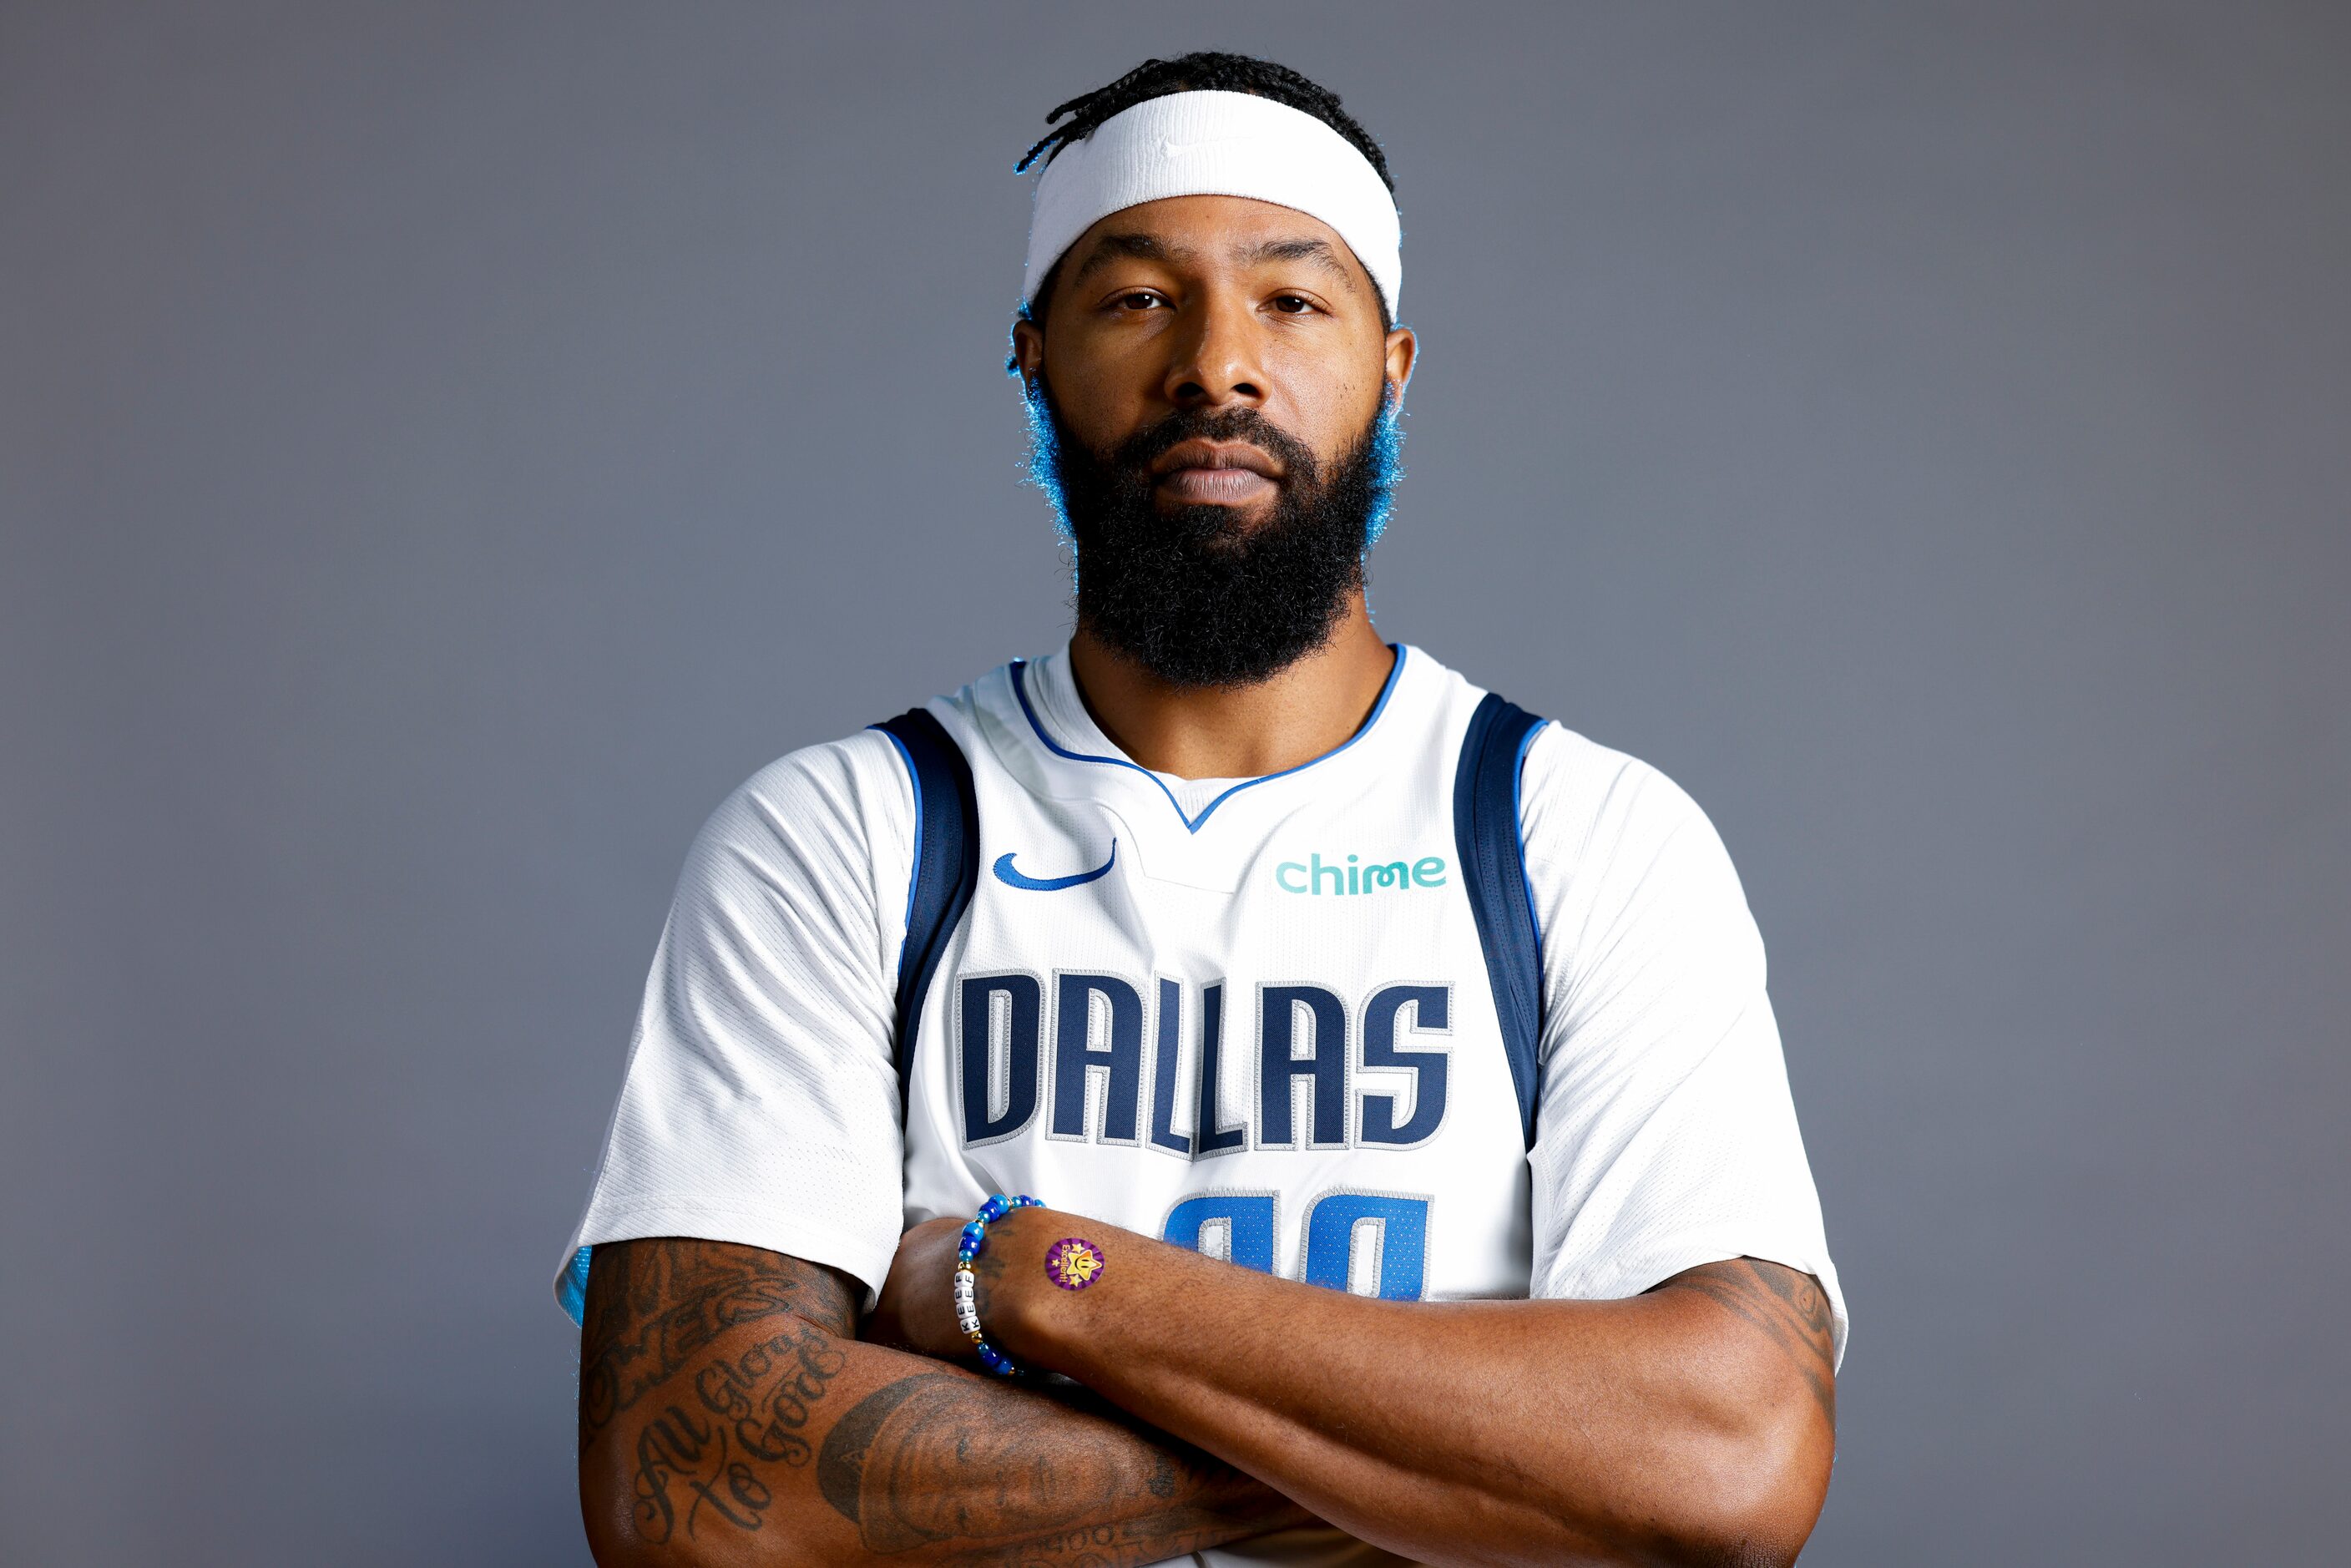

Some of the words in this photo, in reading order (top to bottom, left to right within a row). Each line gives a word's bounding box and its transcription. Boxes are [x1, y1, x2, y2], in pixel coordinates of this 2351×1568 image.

[1276, 852, 1447, 896] chime
[955, 968, 1456, 1162] DALLAS
[1059, 1244, 1070, 1282] Excellent!
[964, 1274, 980, 1328] KEEF
[632, 1406, 711, 1545] All
